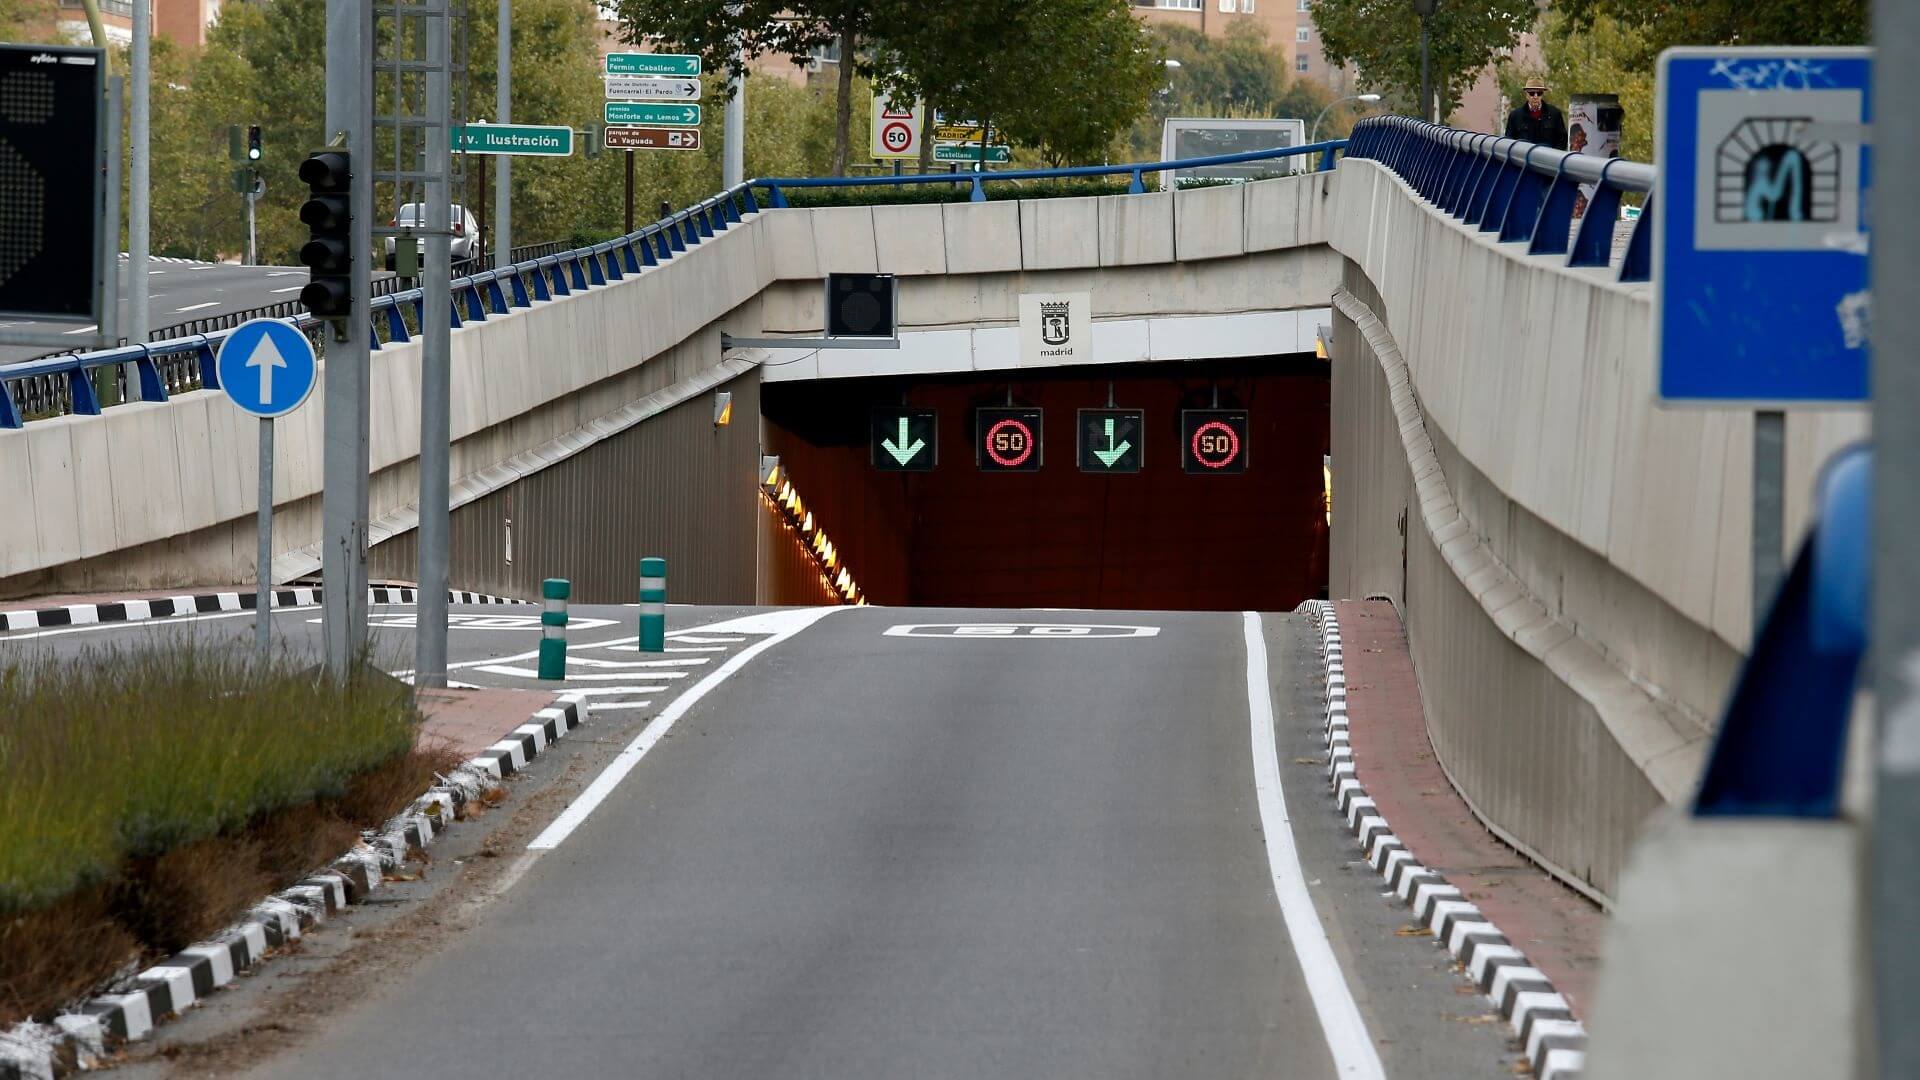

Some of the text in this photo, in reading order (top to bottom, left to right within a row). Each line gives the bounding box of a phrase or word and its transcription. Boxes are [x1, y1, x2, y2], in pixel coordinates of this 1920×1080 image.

[639, 64, 676, 72] Caballero
[486, 133, 560, 147] Ilustración
[621, 137, 654, 145] Vaguada
[888, 132, 906, 143] 50
[936, 151, 972, 159] Castellana
[1040, 347, 1073, 357] madrid
[996, 433, 1023, 451] 50
[1201, 435, 1229, 453] 50
